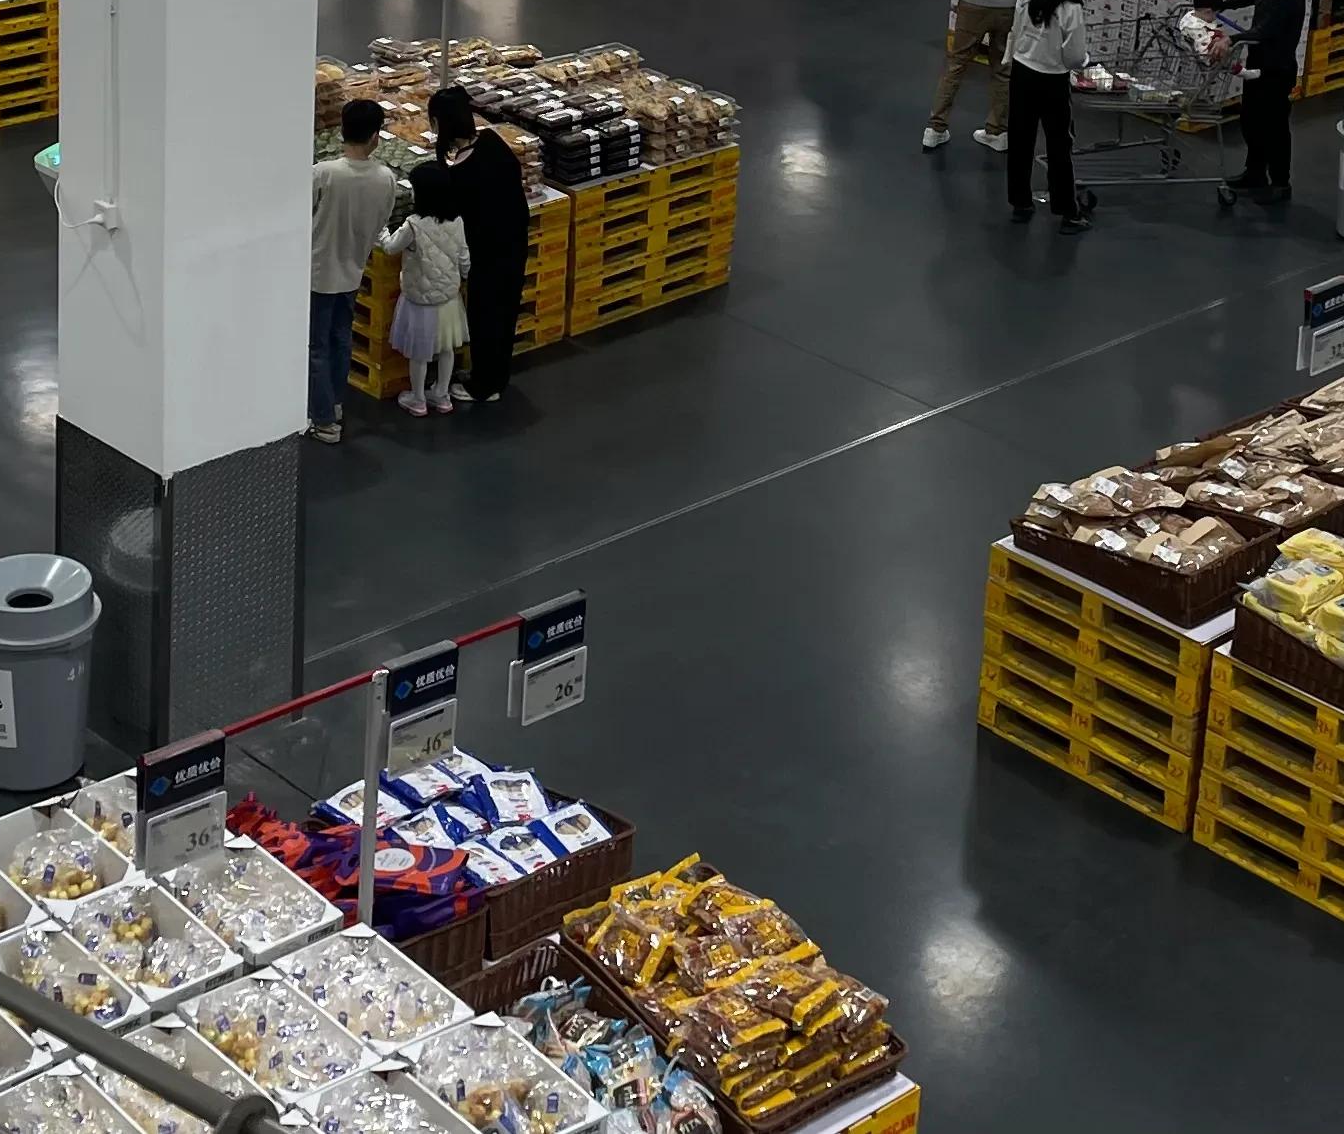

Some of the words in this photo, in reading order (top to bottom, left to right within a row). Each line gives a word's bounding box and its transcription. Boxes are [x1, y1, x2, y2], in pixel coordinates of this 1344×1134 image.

[554, 679, 574, 702] 26
[421, 732, 443, 755] 46
[185, 826, 211, 852] 36
